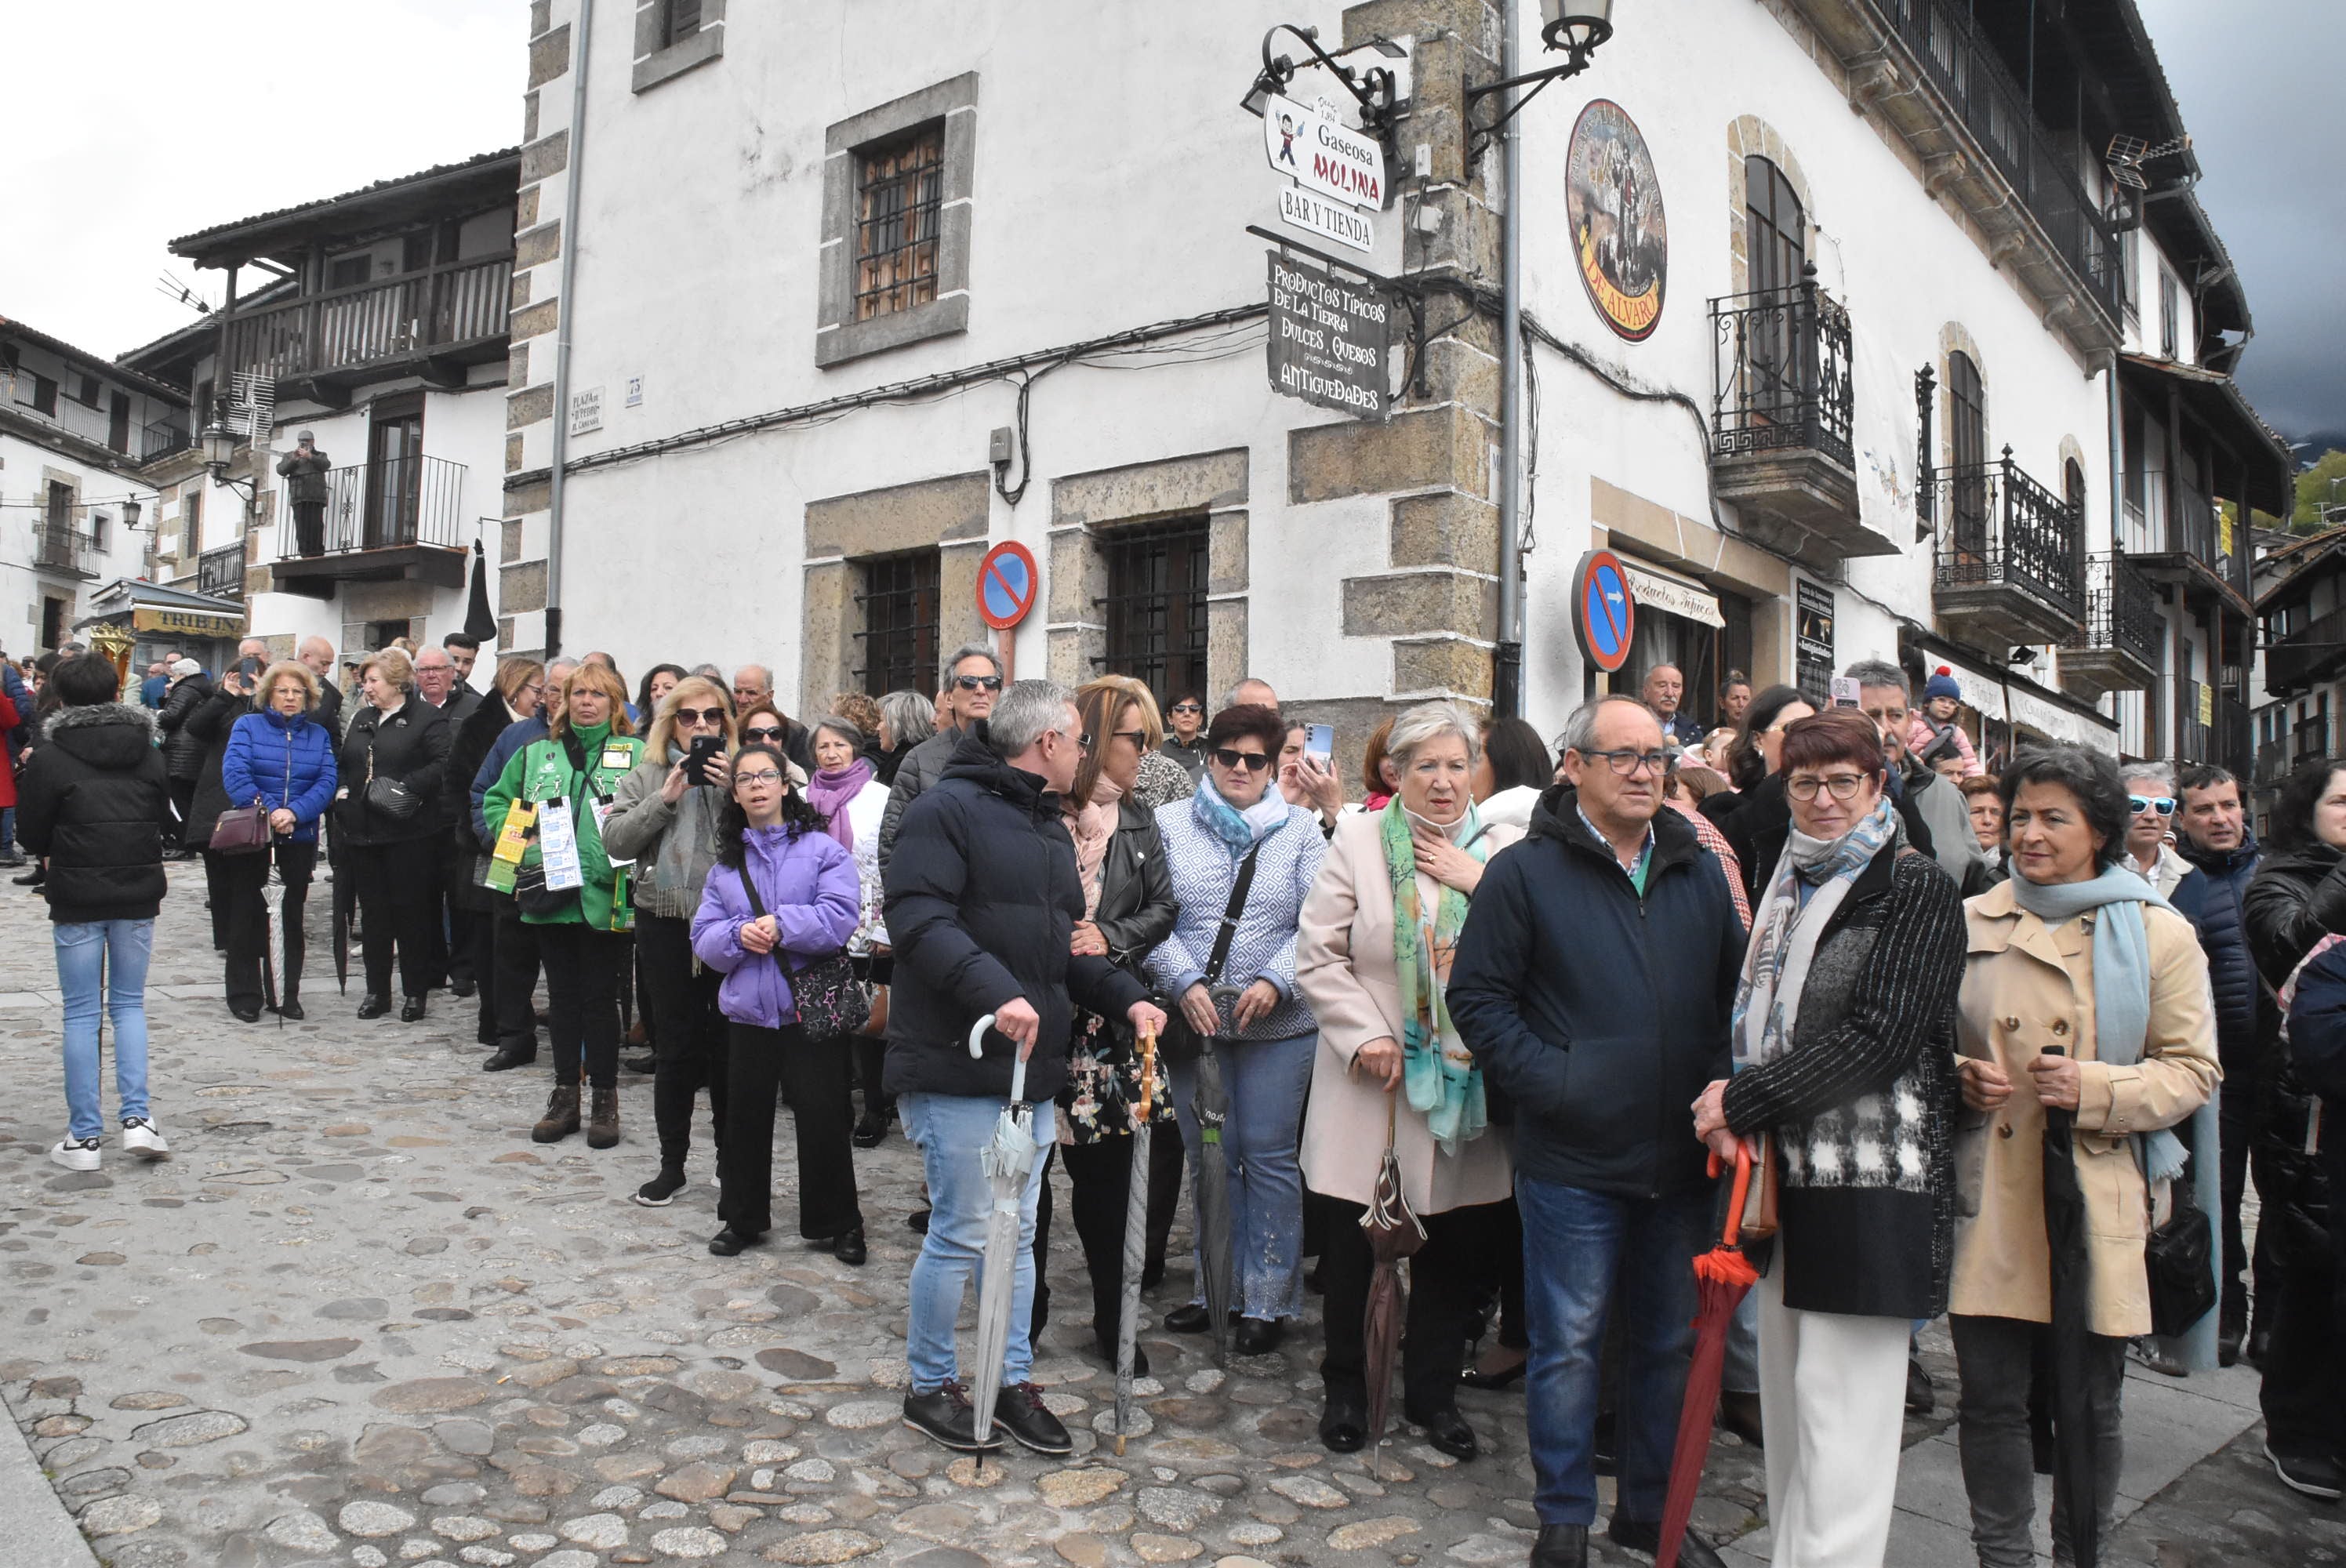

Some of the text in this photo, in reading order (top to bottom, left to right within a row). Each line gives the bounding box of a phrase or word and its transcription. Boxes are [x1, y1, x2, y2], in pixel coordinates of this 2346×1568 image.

[1318, 125, 1373, 166] Gaseosa
[1313, 153, 1379, 205] MOLINA
[1285, 191, 1371, 245] BAR Y TIENDA
[1274, 264, 1339, 308] PRODUCTOS
[1274, 287, 1349, 332] DE LA TIERRA
[1585, 258, 1607, 301] DE
[1607, 292, 1655, 325] ALVARO
[1281, 316, 1324, 350] DULCES
[1332, 336, 1376, 367] QUESOS
[573, 393, 593, 408] PLAZA
[1280, 363, 1378, 410] ANTIGUEDADES
